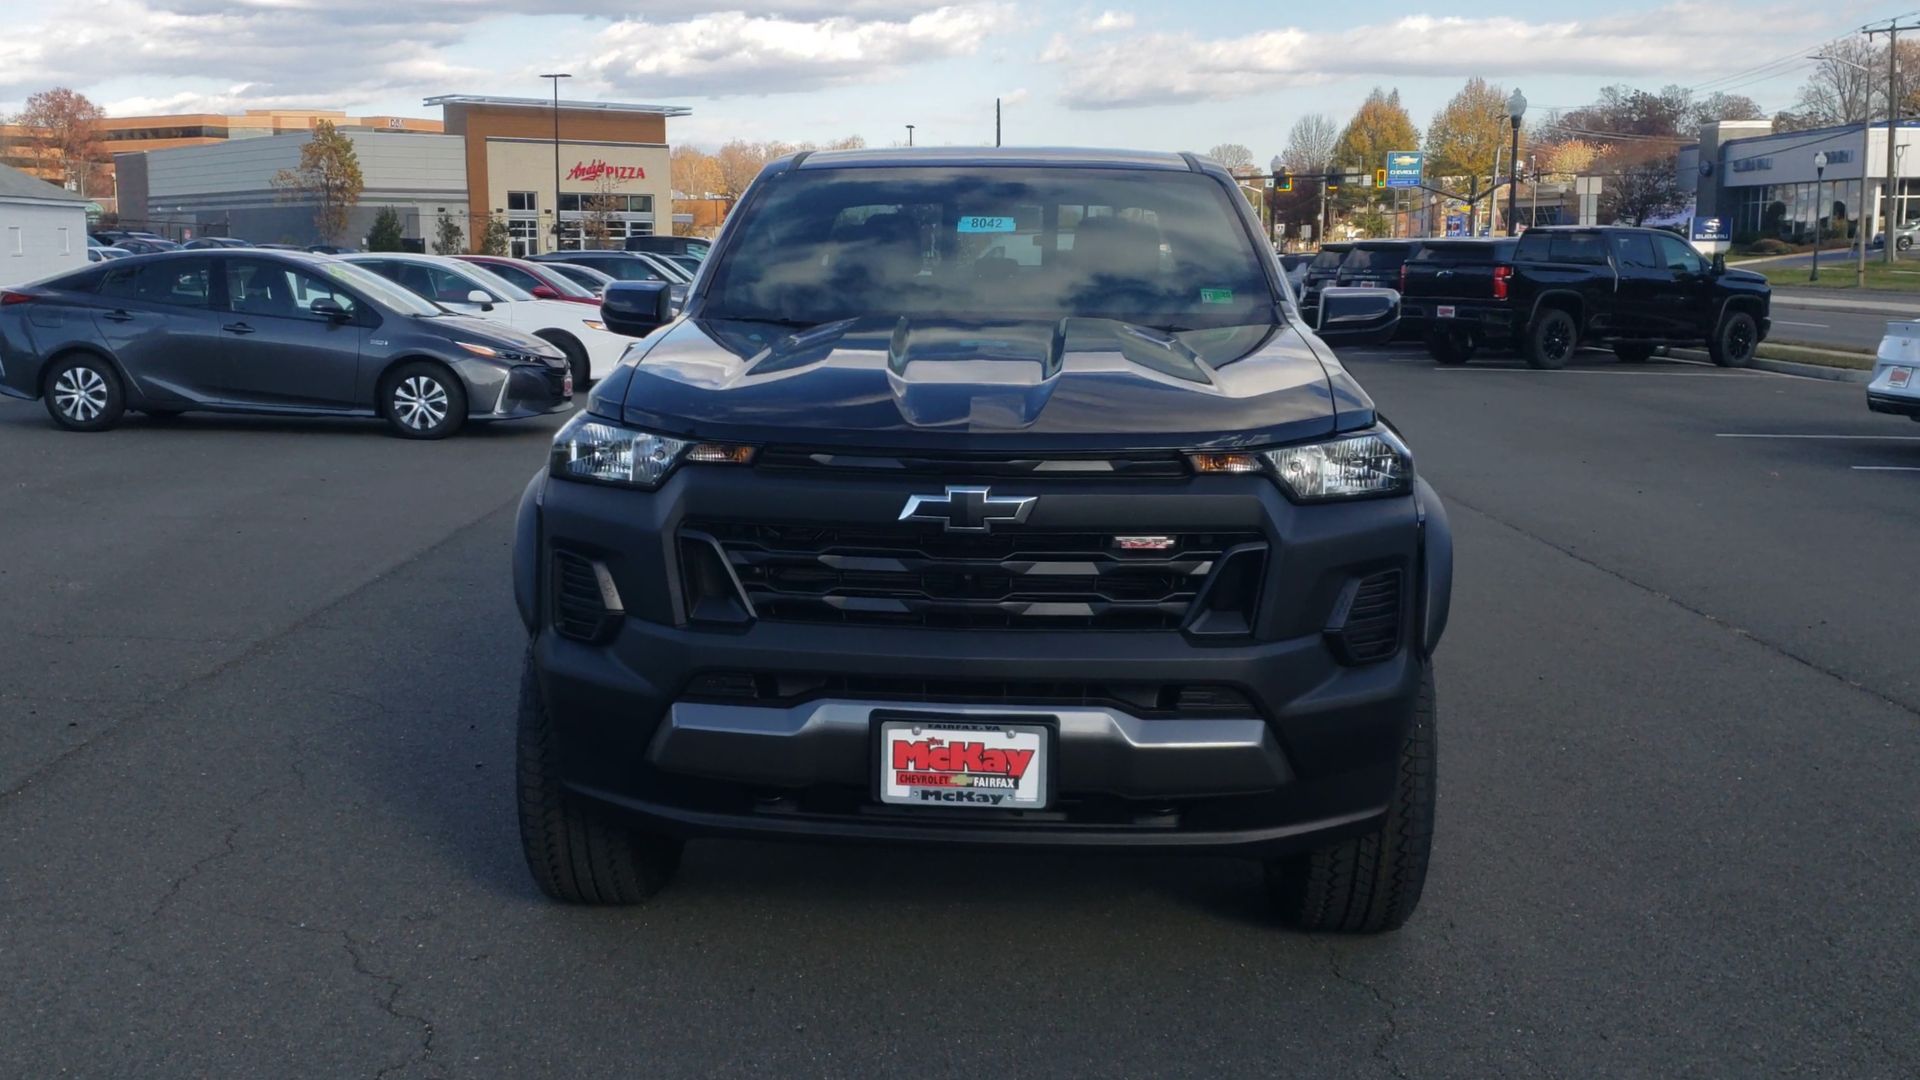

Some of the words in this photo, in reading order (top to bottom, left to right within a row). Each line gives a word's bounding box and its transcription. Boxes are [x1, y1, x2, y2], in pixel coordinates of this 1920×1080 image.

[566, 159, 606, 181] Andy's
[606, 166, 646, 179] PIZZA
[971, 218, 1002, 229] 8042
[892, 739, 1035, 779] McKay
[899, 773, 949, 785] CHEVROLET
[973, 776, 1015, 788] FAIRFAX
[920, 790, 1005, 805] McKay
